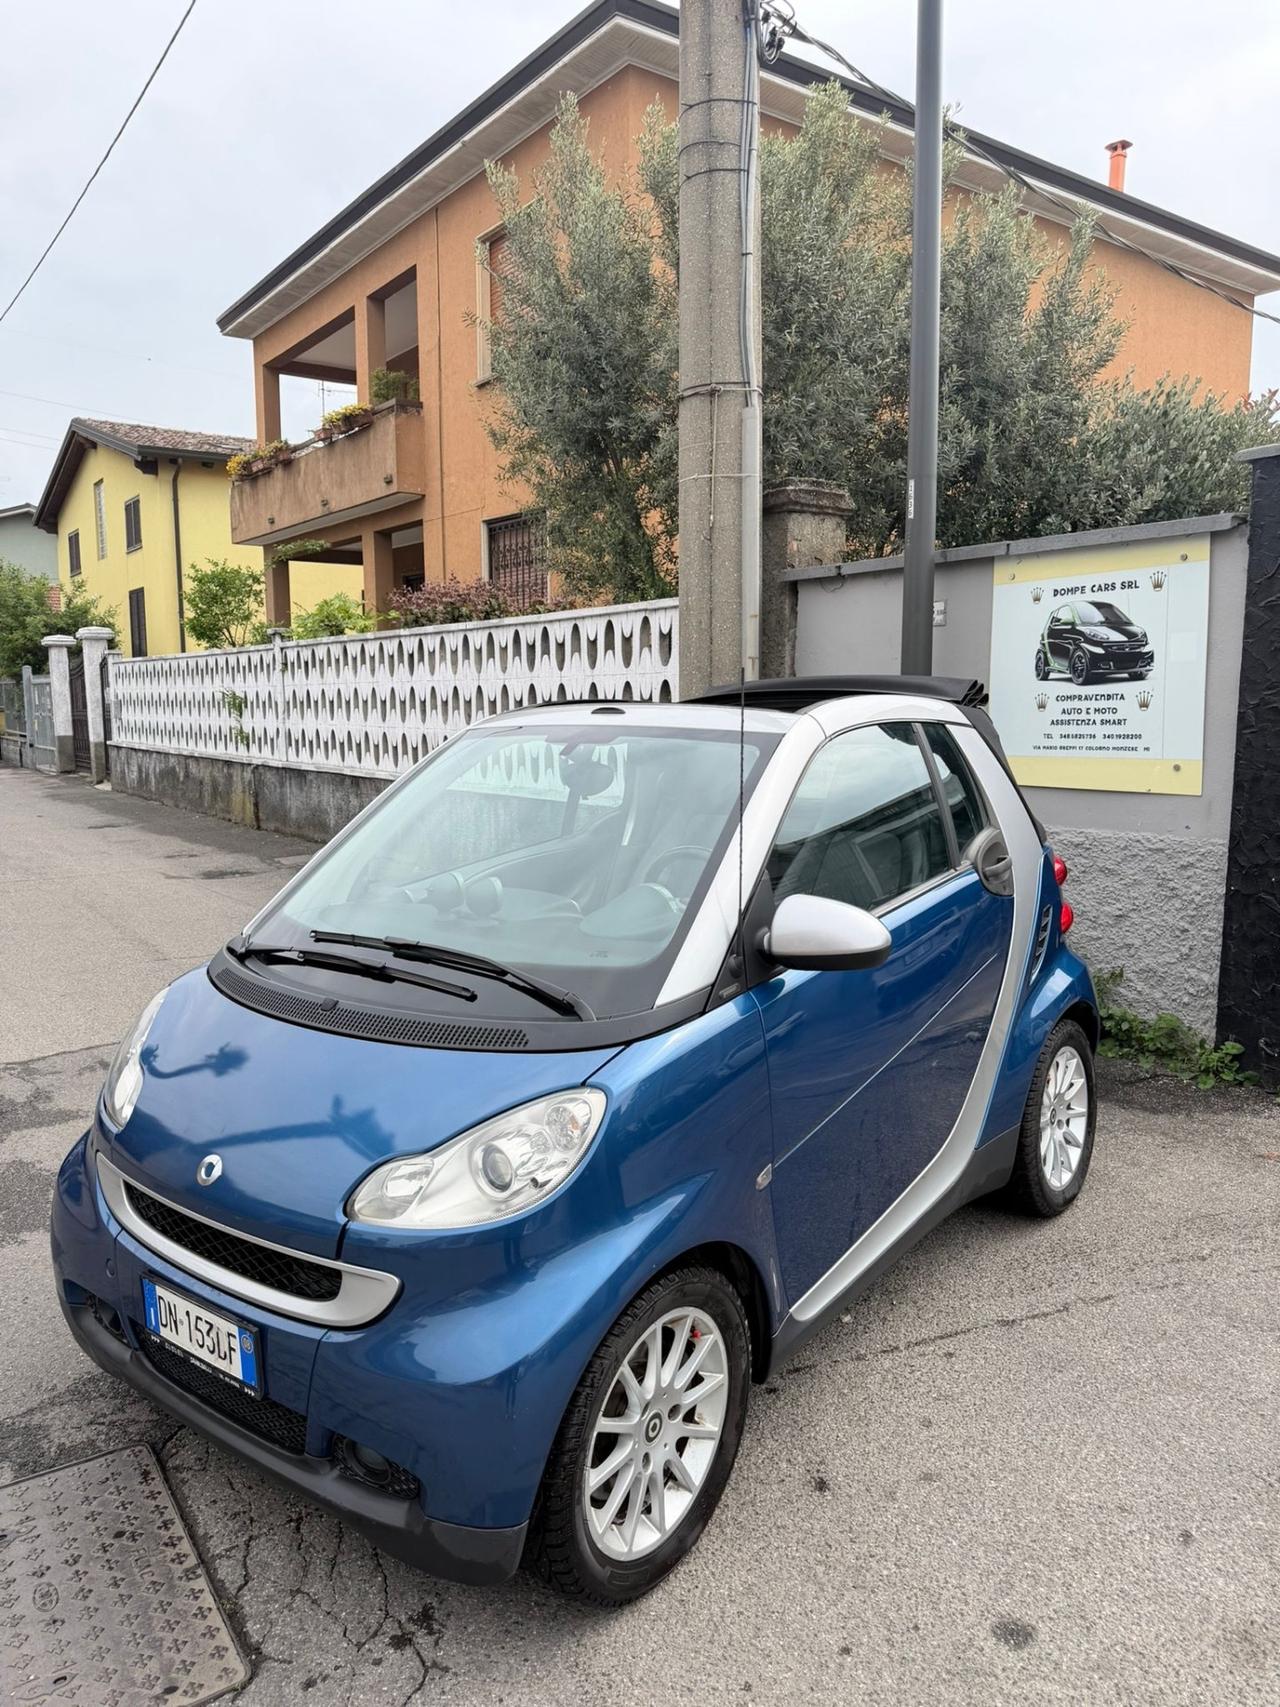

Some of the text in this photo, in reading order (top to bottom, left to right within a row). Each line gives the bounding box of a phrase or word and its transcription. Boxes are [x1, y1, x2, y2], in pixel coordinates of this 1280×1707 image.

[1053, 580, 1140, 597] DOMPE CARS SRL
[1055, 693, 1126, 702] COMPRAVENDITA
[1061, 707, 1083, 715] AUTO
[1094, 707, 1118, 715] MOTO
[1100, 718, 1127, 726] SMART
[158, 1295, 179, 1336] DN
